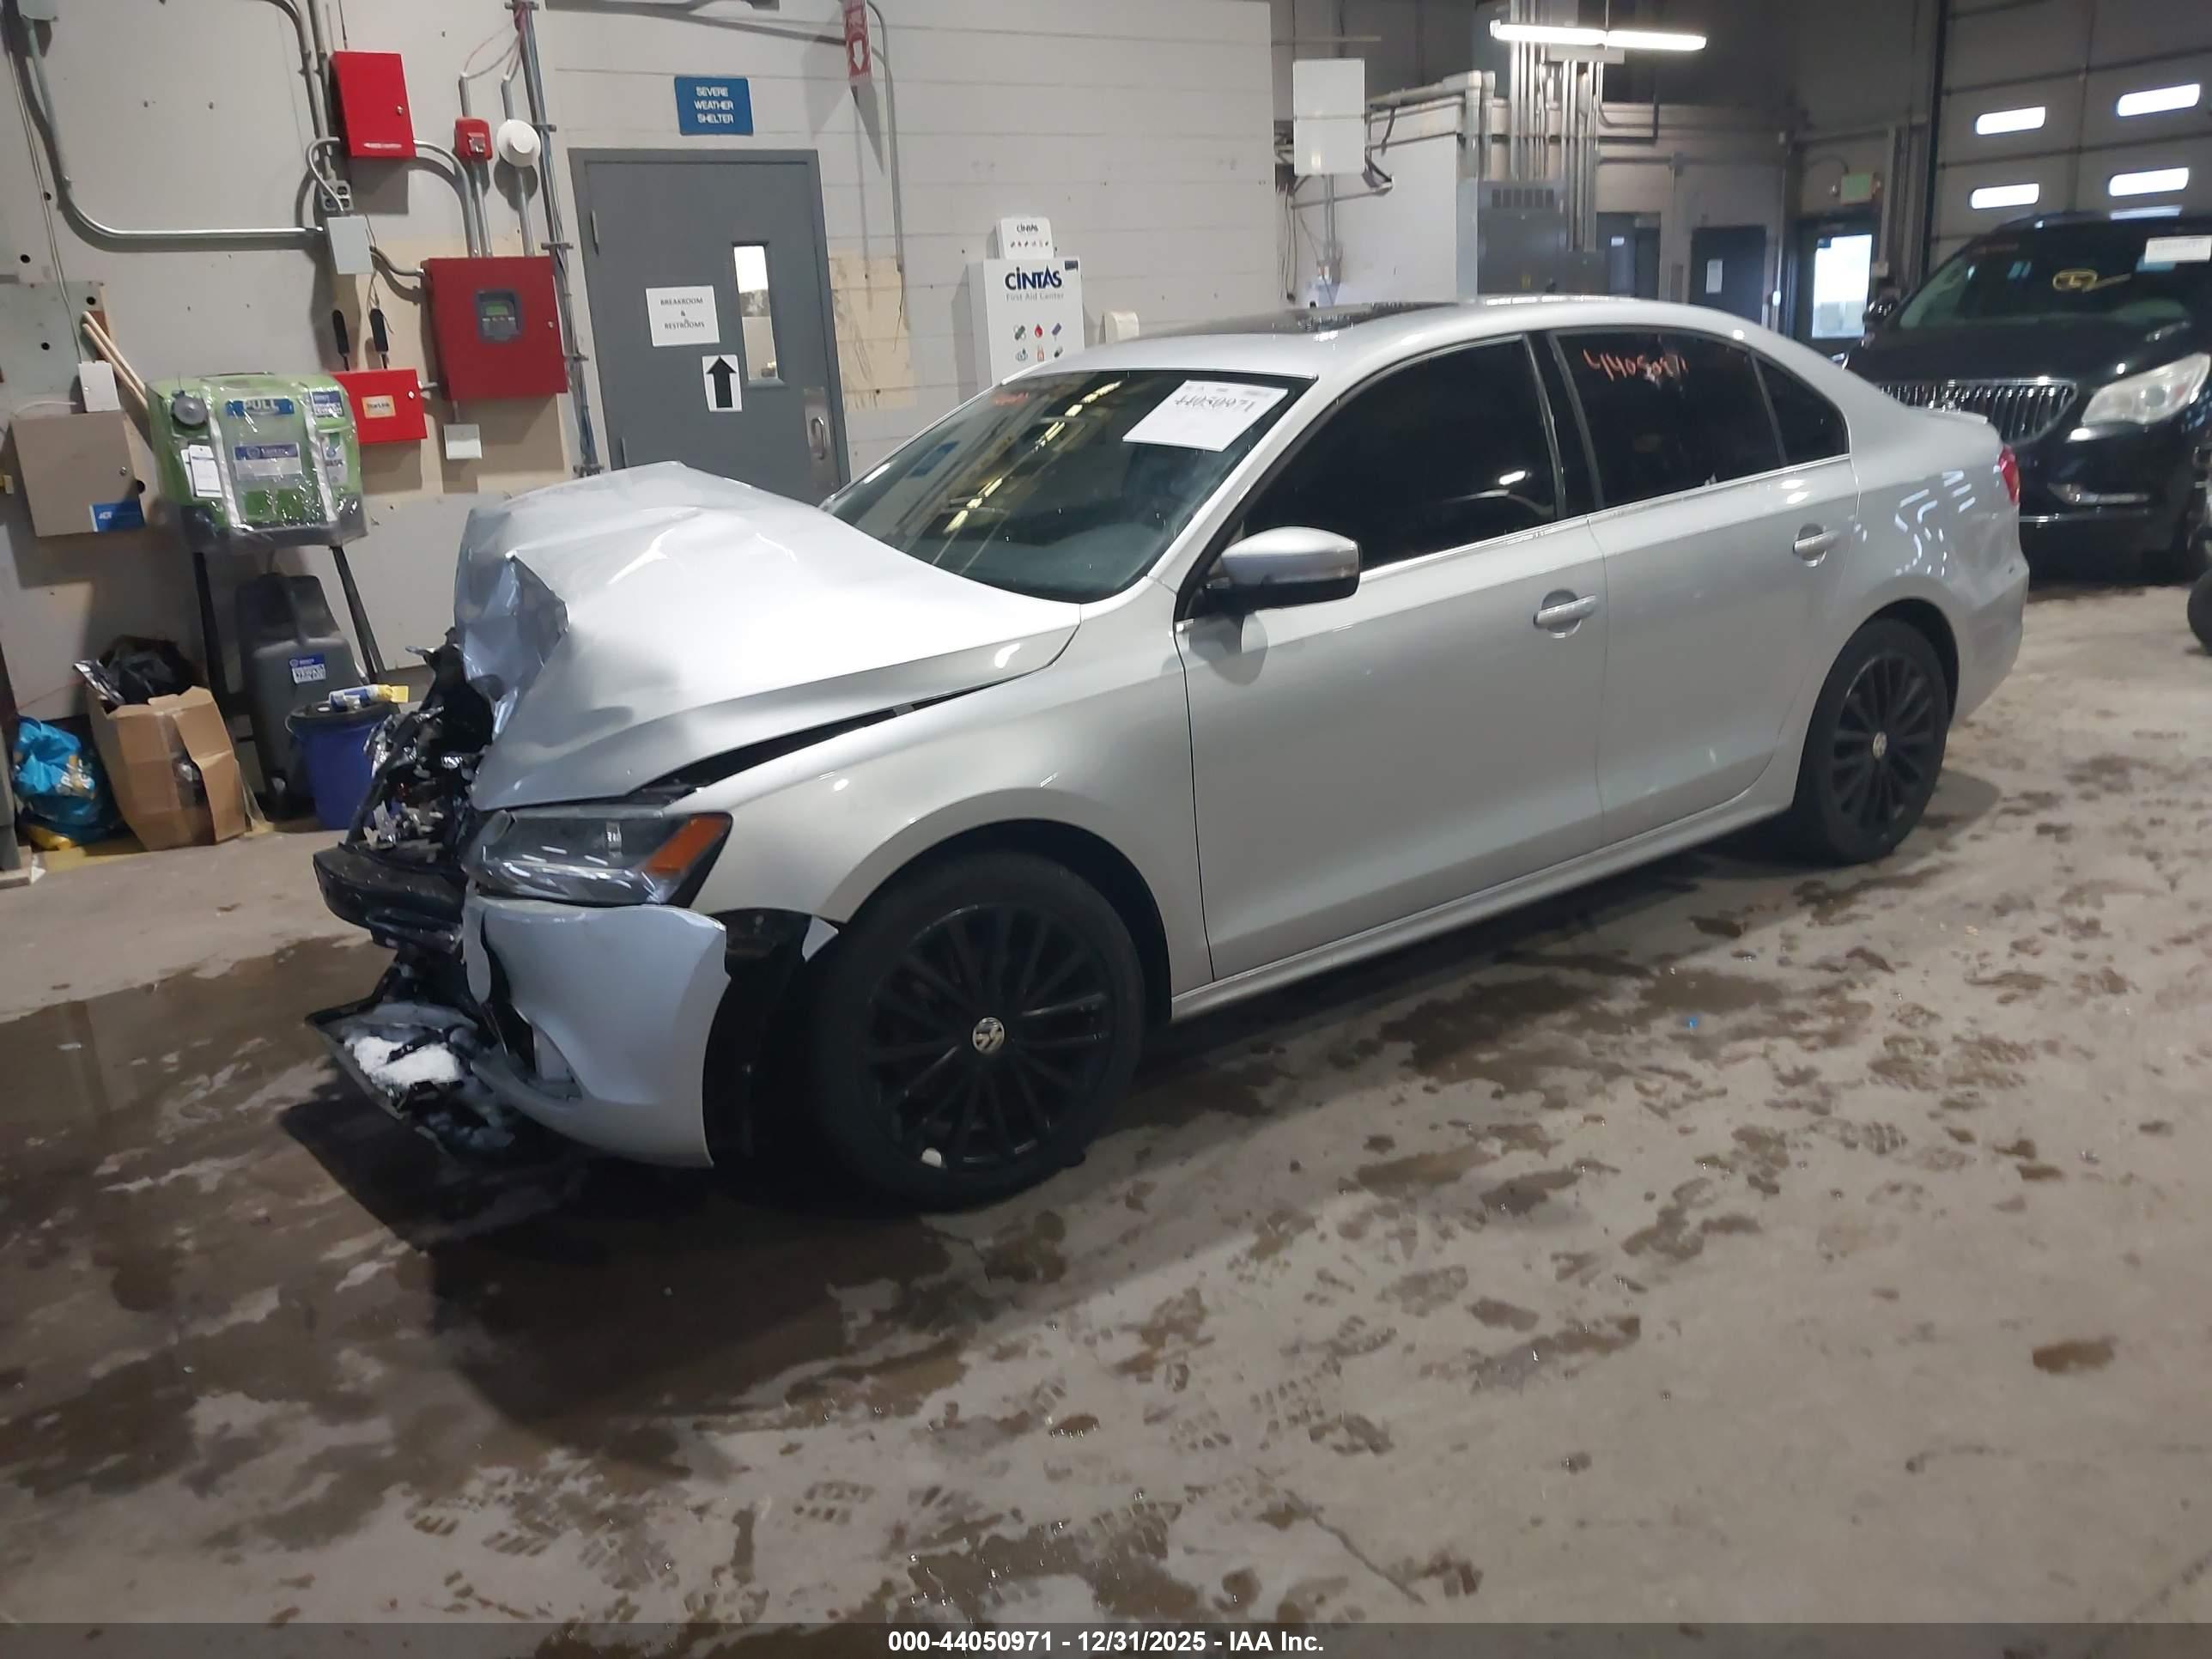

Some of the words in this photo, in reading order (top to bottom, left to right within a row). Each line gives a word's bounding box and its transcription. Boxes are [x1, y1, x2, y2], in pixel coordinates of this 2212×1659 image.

[696, 86, 728, 97] SEVERE
[694, 100, 734, 110] WEATHER
[696, 113, 734, 124] SHELTER
[1005, 264, 1063, 290] CINTAS
[1006, 293, 1022, 301] First
[1025, 292, 1037, 301] Aid
[1040, 291, 1064, 300] Center
[660, 297, 704, 306] BREAKROOM
[664, 321, 705, 330] RESTROOMS
[243, 399, 280, 412] PULL
